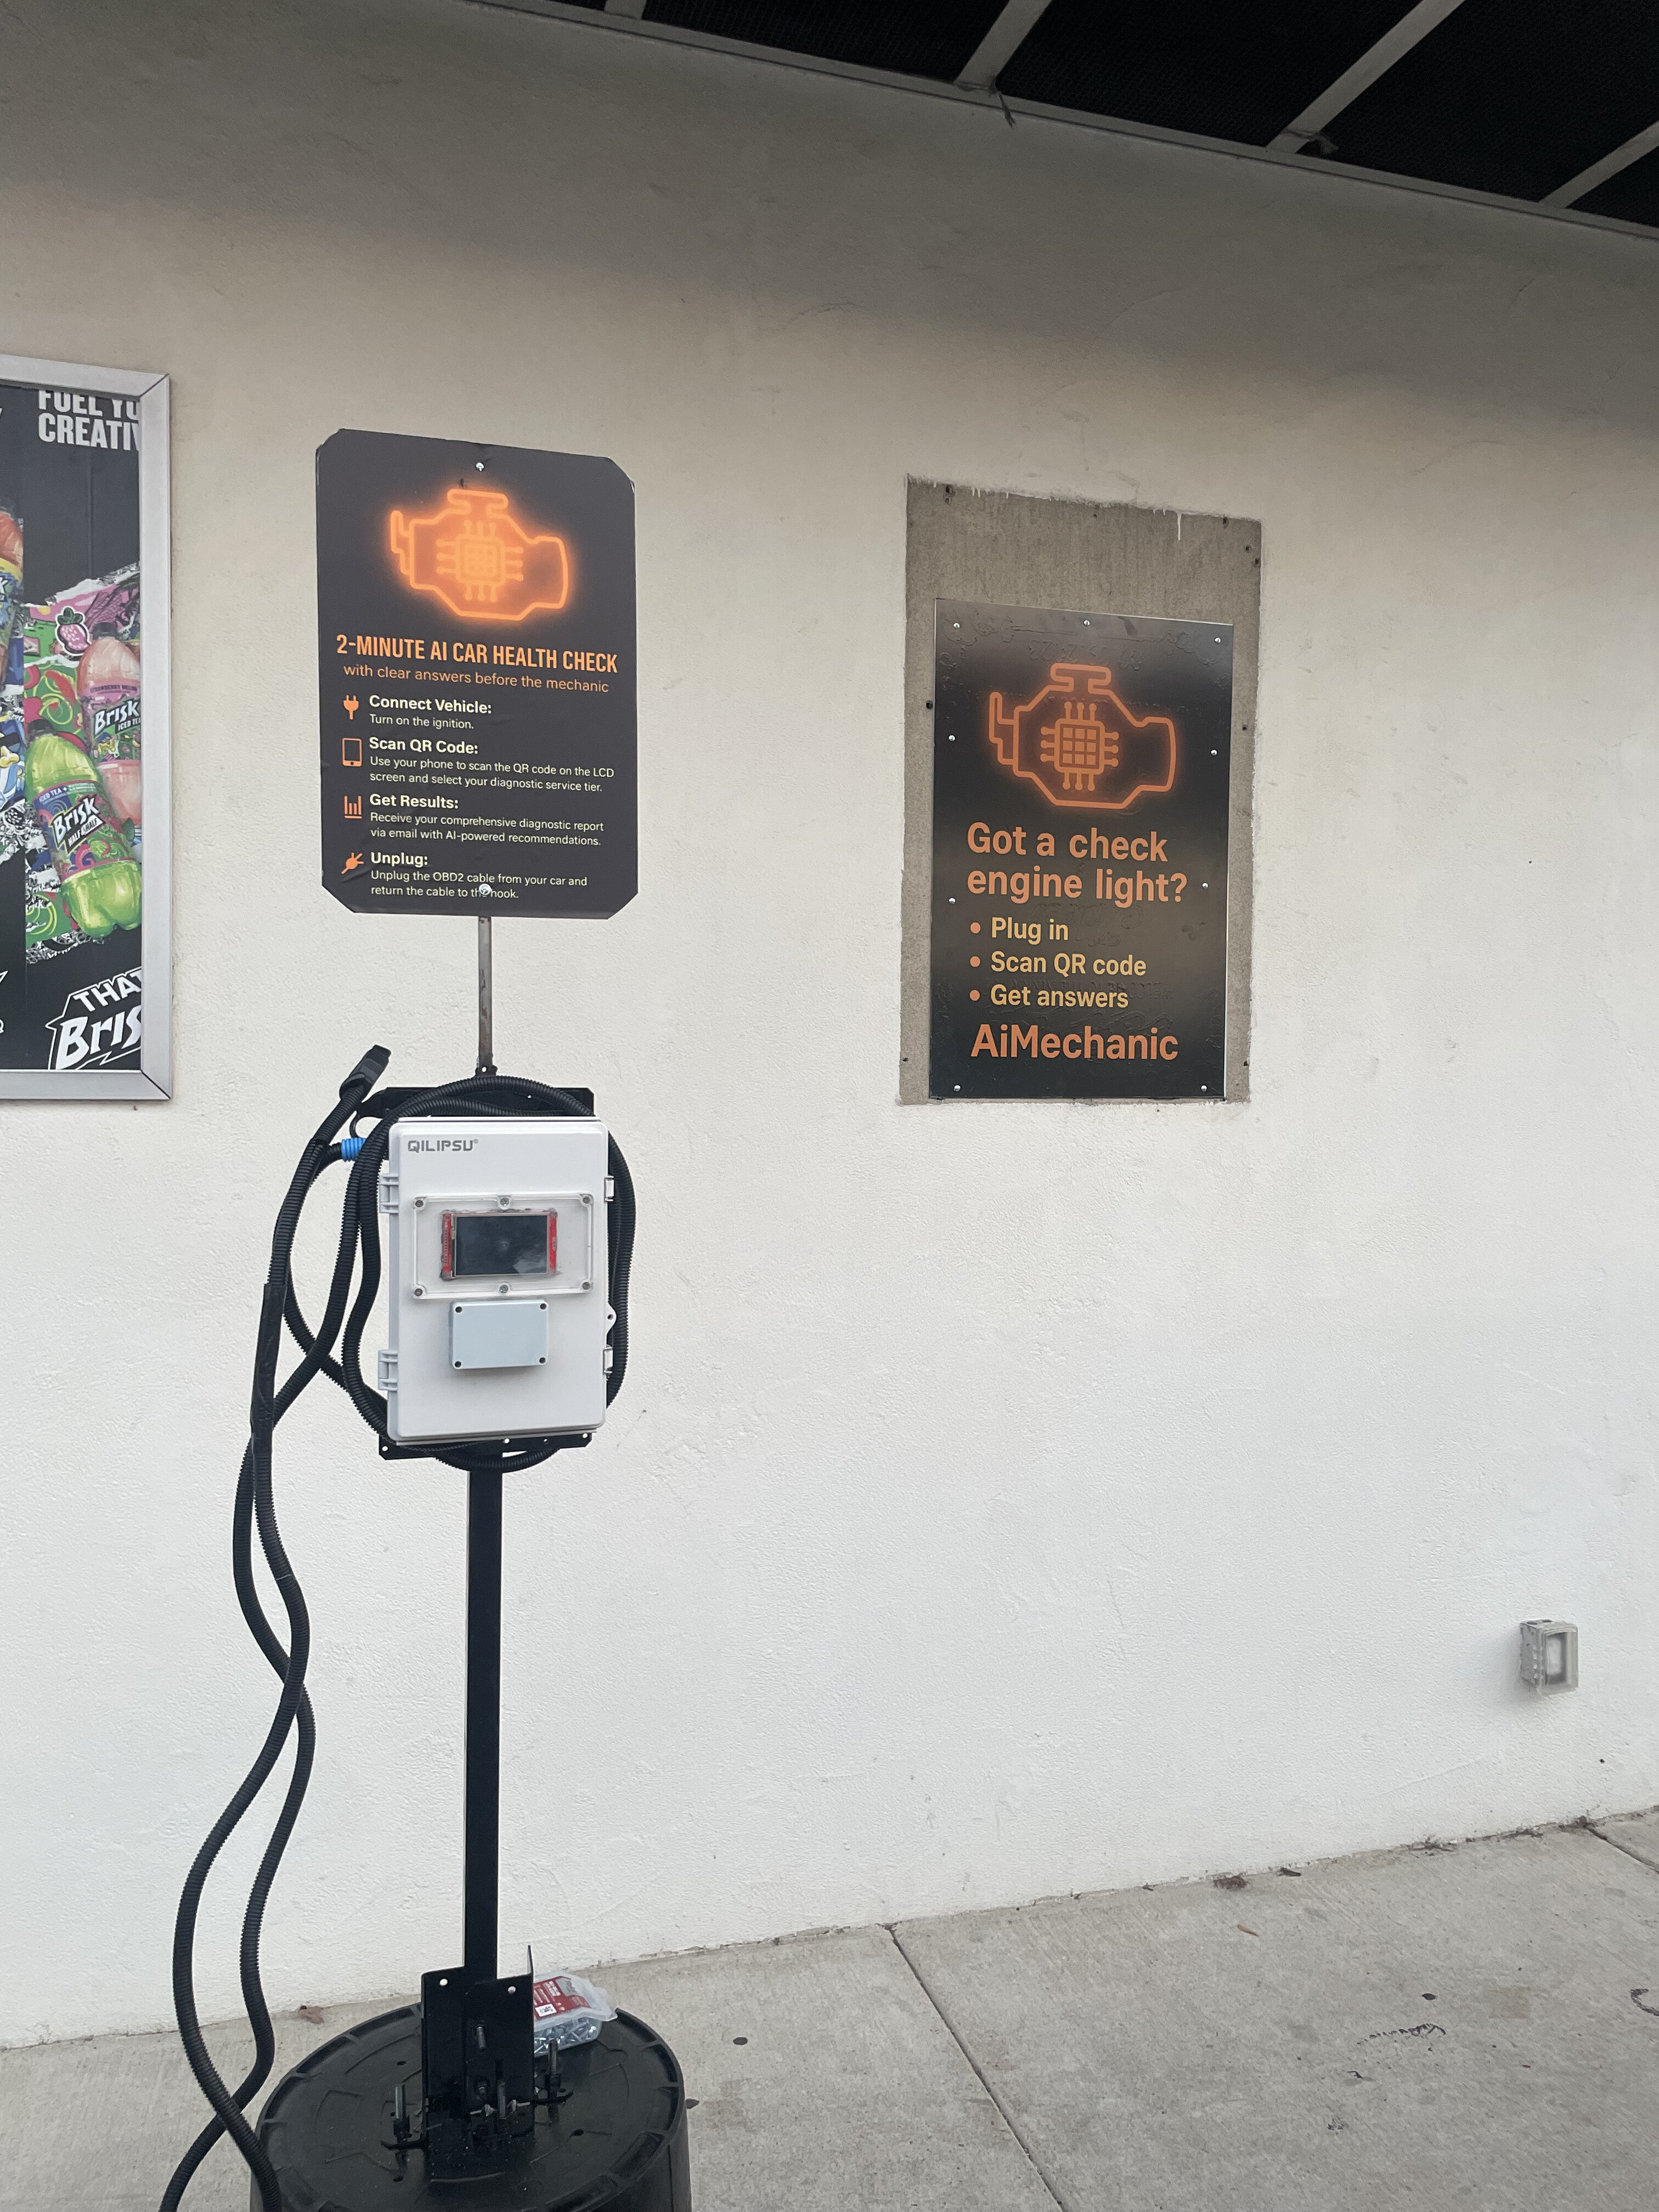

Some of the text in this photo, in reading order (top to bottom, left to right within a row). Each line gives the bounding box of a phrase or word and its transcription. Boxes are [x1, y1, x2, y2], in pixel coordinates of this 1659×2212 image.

[38, 390, 103, 417] FUEL
[336, 634, 618, 673] 2-MINUTE AI CAR HEALTH CHECK
[343, 663, 609, 693] with clear answers before the mechanic
[369, 695, 492, 714] Connect Vehicle:
[94, 700, 140, 736] Brisk
[369, 713, 474, 730] Turn on the ignition.
[369, 736, 478, 754] Scan QR Code:
[370, 756, 391, 766] Use
[393, 759, 417, 769] your
[420, 758, 454, 770] phone
[456, 760, 466, 770] to
[469, 763, 492, 771] scan
[494, 762, 511, 772] the
[513, 763, 529, 774] QR
[532, 764, 557, 775] code
[574, 766, 591, 776] the
[593, 768, 614, 777] LCD
[370, 773, 602, 792] screen and select your diagnostic service tier.
[369, 793, 459, 809] Get Results:
[53, 797, 99, 844] Brisk
[370, 812, 604, 833] Receive your comprehensive diagnostic report
[370, 827, 601, 846] via email with AI-powered recommendations.
[967, 822, 1168, 862] Got a check
[371, 851, 428, 868] Unplug:
[371, 870, 410, 883] Unplug
[413, 871, 431, 881] the
[432, 872, 464, 882] OBD2
[467, 873, 495, 883] cable
[498, 873, 522, 884] from
[524, 877, 548, 887] your
[568, 876, 587, 886] and
[967, 865, 1187, 909] engine light?
[371, 885, 519, 899] return the cable to th hook.
[991, 917, 1041, 945] Plug
[1049, 918, 1068, 941] in
[991, 951, 1147, 978] Scan QR code
[990, 984, 1031, 1006] Get
[1037, 990, 1128, 1008] answers
[970, 1024, 1178, 1060] AiMechanic
